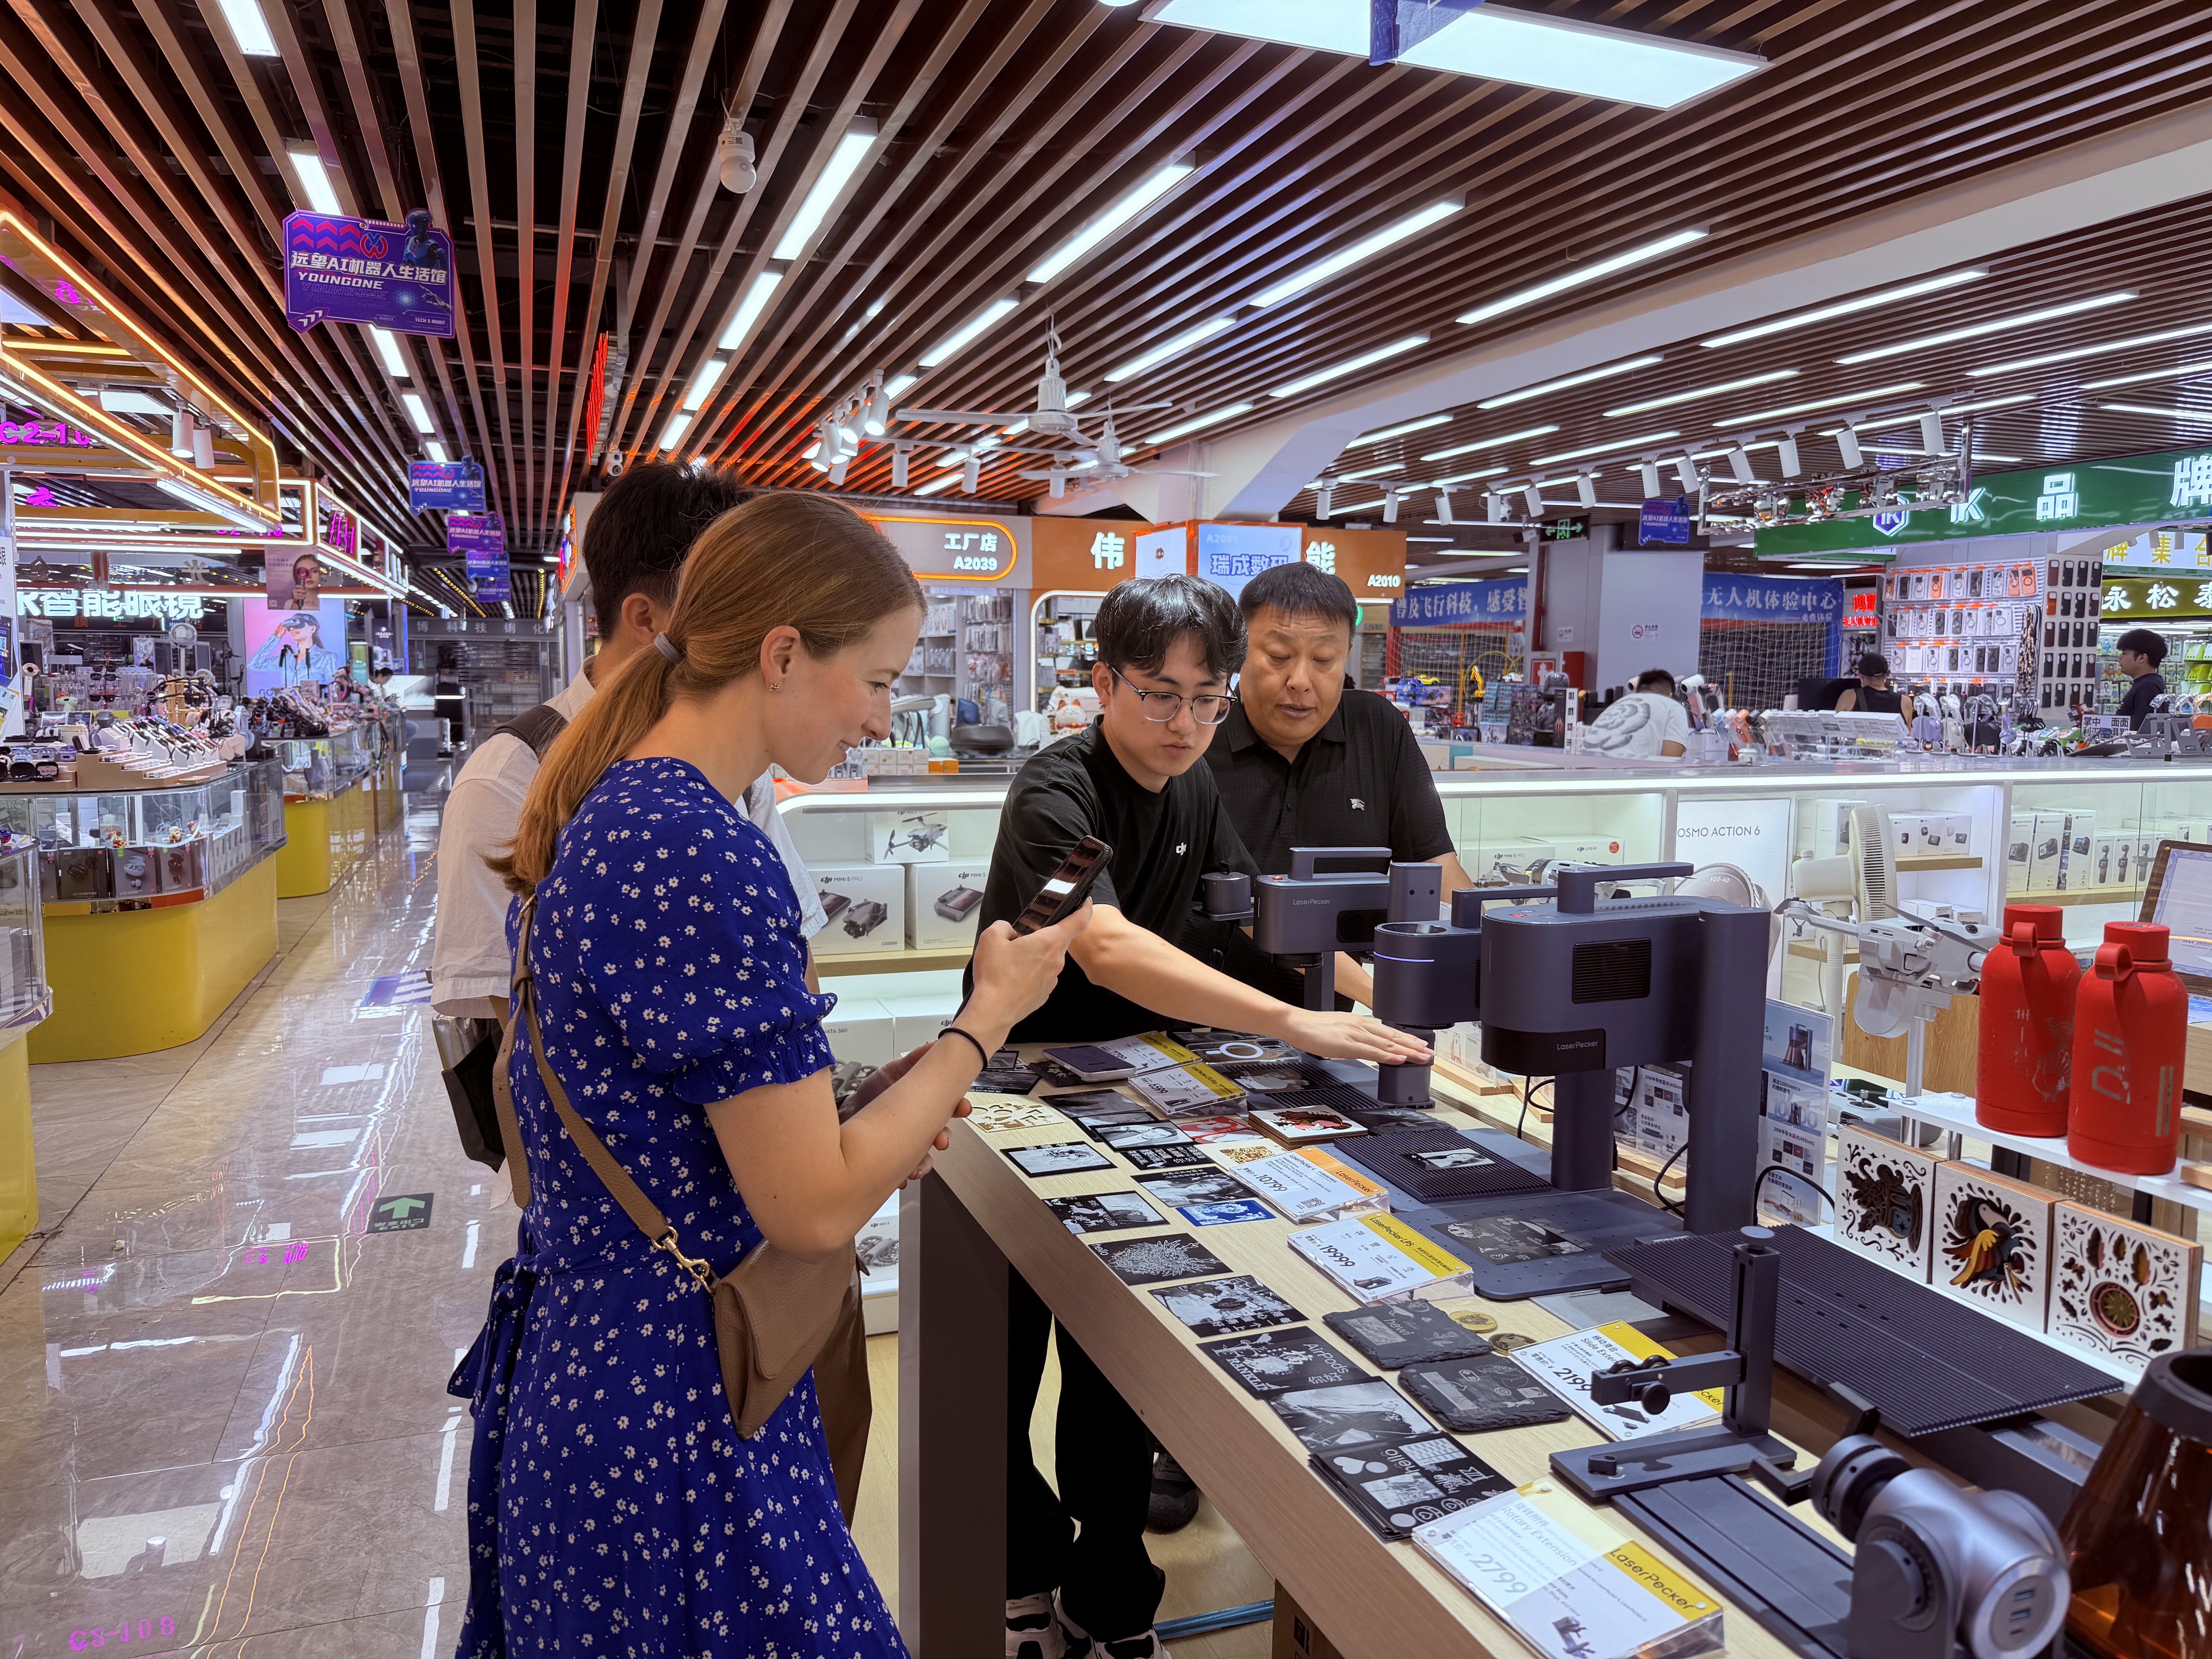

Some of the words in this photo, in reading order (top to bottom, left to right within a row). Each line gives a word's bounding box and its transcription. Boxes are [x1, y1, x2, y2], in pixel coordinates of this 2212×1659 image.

[291, 251, 447, 283] 远望AI机器人生活馆
[298, 272, 385, 289] YOUNGONE
[412, 479, 482, 488] 远望AI机器人生活馆
[944, 532, 998, 552] 工厂店
[1090, 532, 1125, 570] 伟
[953, 556, 998, 571] A2039
[1306, 541, 1336, 575] 能
[1367, 574, 1400, 587] A2010
[1706, 587, 1836, 611] 无人机体验中心
[1677, 827, 1709, 838] OSMO
[1711, 826, 1752, 837] ACTION
[1754, 826, 1760, 836] 6
[1557, 1041, 1598, 1050] LaserPecker
[1148, 1082, 1168, 1094] 6599
[1255, 1173, 1288, 1192] 10799
[1336, 1170, 1373, 1193] LaserPecker
[374, 1218, 424, 1227] 安全出口
[1369, 1217, 1406, 1240] LaserPecker
[1400, 1238, 1415, 1247] LP5
[1092, 1243, 1108, 1256] hello
[1318, 1244, 1357, 1268] 19999
[1219, 1317, 1292, 1333] 每一个上帝
[1384, 1319, 1414, 1335] hewi
[1580, 1337, 1600, 1350] Slide
[1596, 1348, 1618, 1363] Exten
[1591, 1335, 1618, 1353] 移动滑台
[1303, 1343, 1348, 1374] AirPods
[1309, 1371, 1342, 1384] 你好
[1551, 1367, 1593, 1393] 2199
[1385, 1449, 1420, 1474] hello
[1513, 1502, 1549, 1527] 旋转附件
[1500, 1506, 1534, 1531] Rotary
[1530, 1528, 1580, 1566] Extension
[1468, 1553, 1532, 1596] 2799
[1609, 1548, 1695, 1611] LaserPecker
